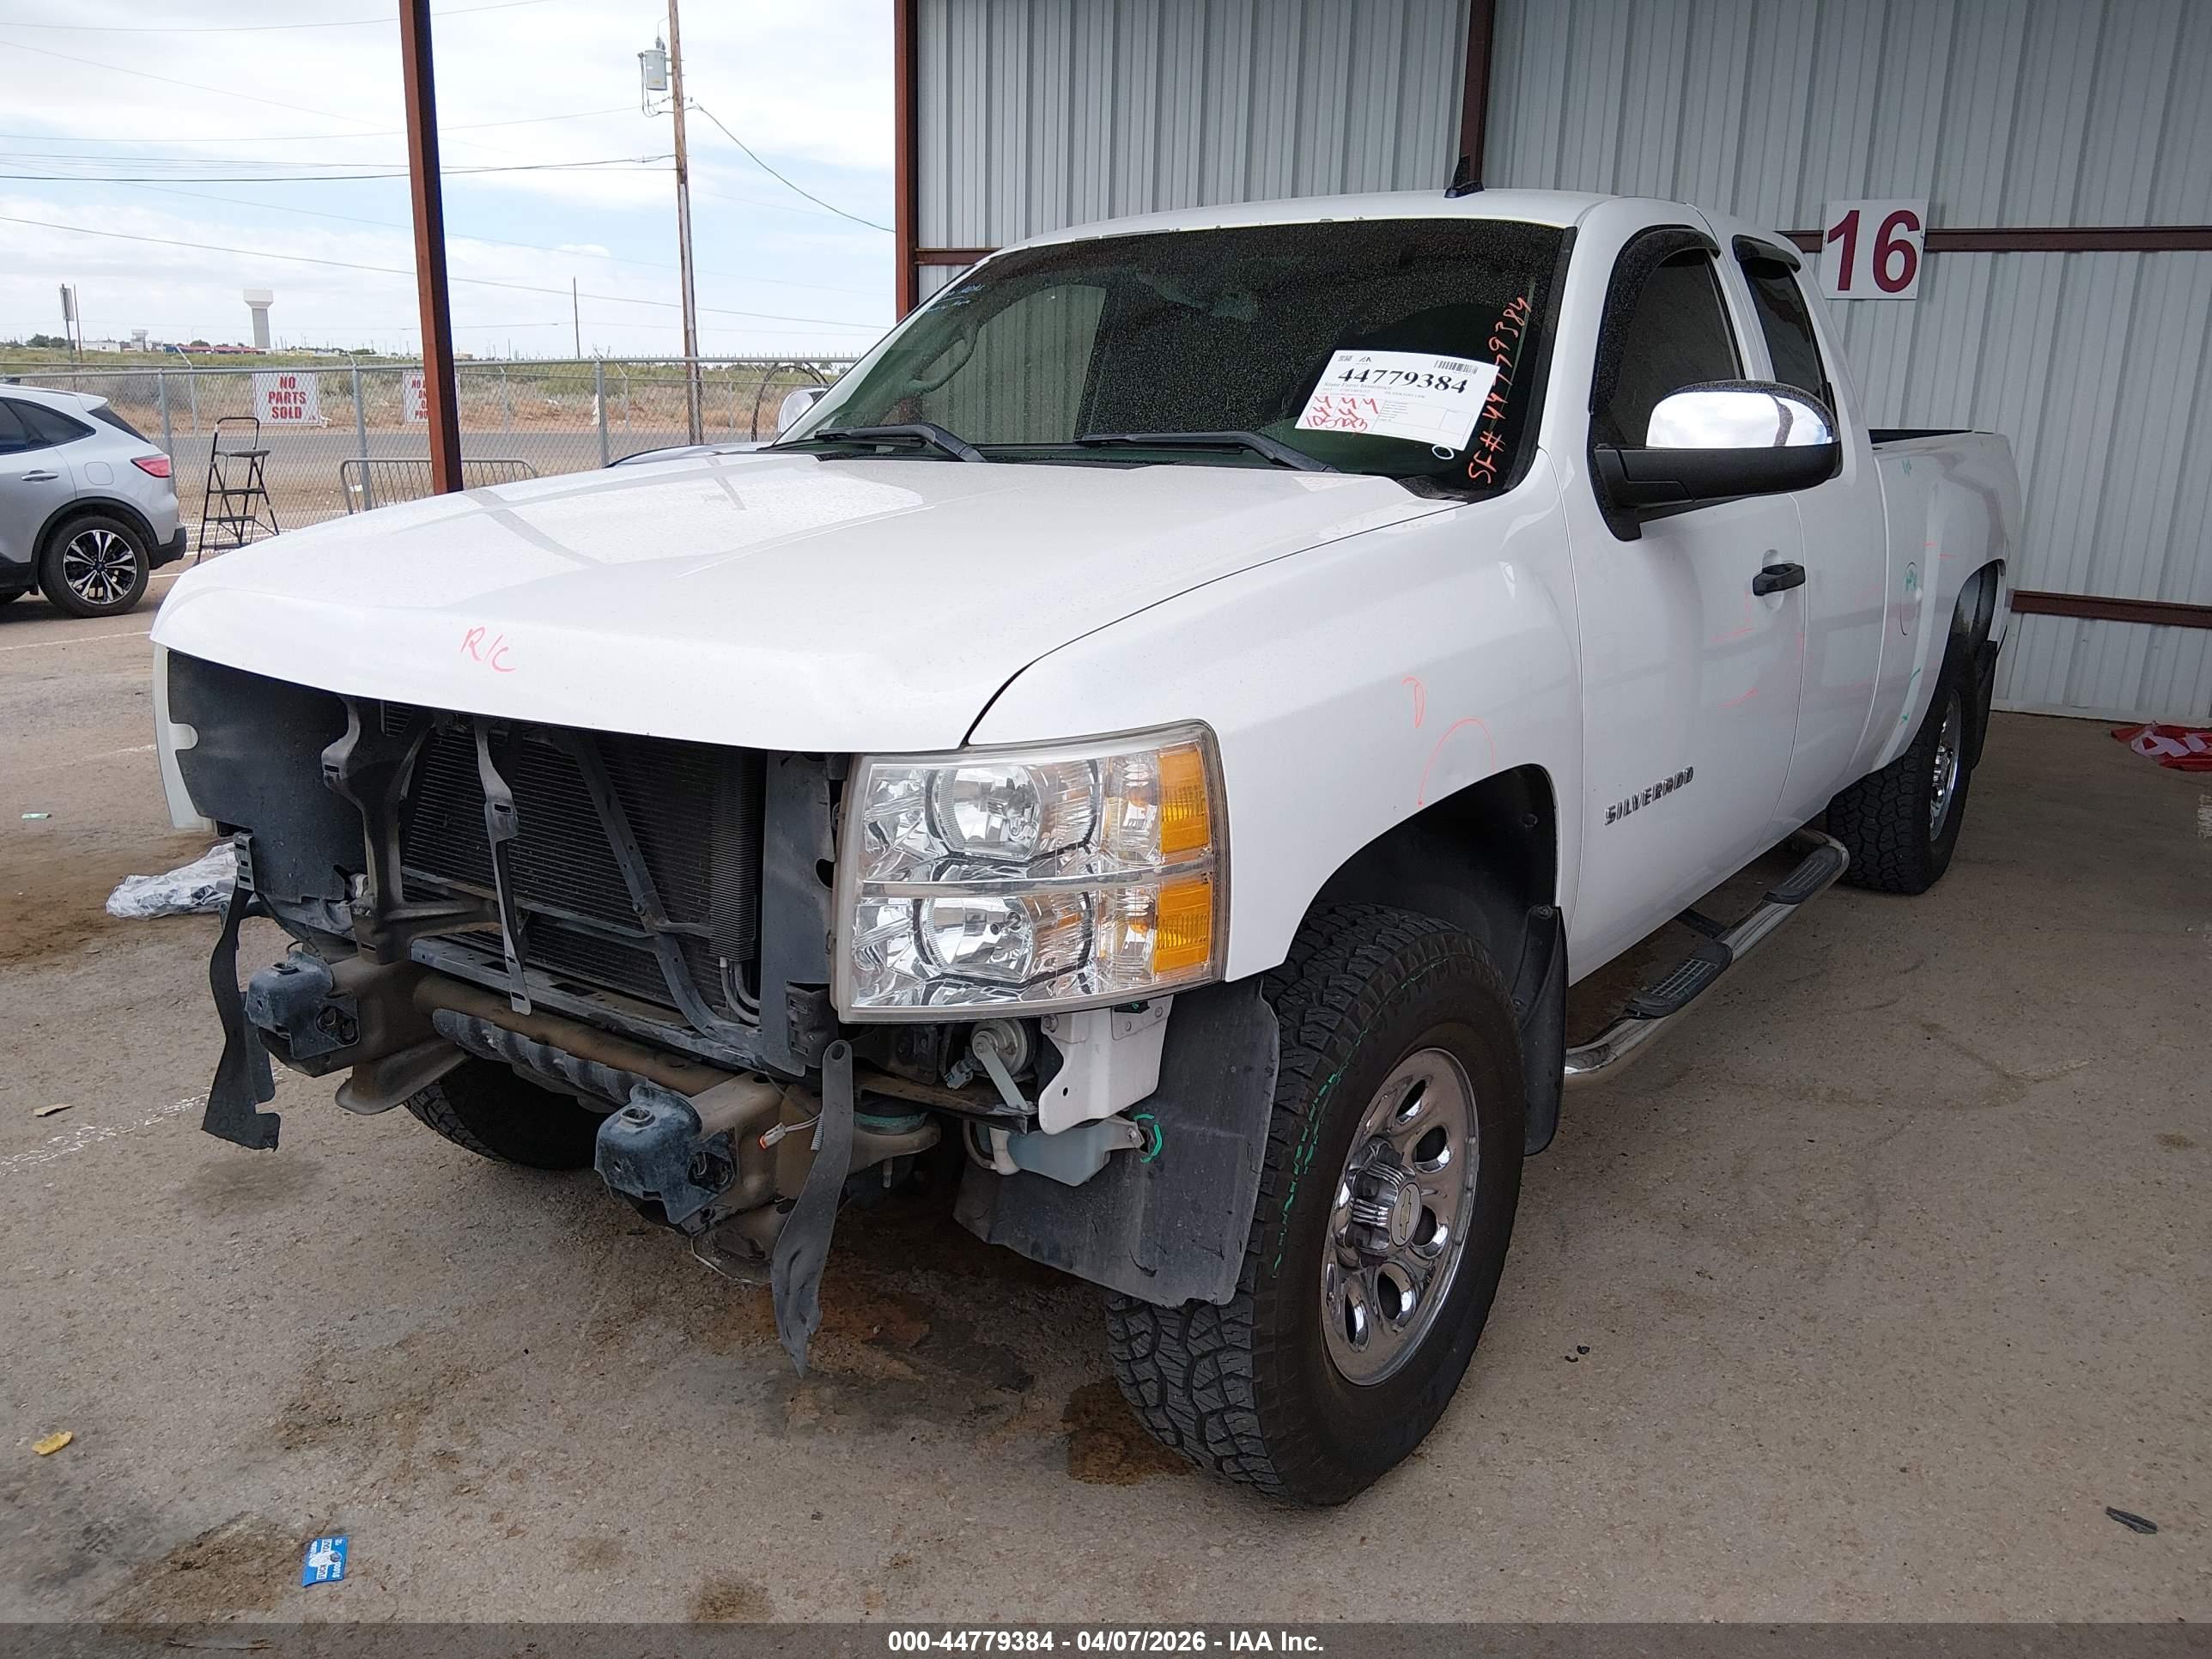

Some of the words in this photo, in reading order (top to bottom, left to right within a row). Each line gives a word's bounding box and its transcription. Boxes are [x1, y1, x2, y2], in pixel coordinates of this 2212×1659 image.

[1826, 210, 1921, 294] 16
[279, 376, 296, 390] NO
[411, 380, 422, 389] NO
[1337, 368, 1468, 394] 44779384
[268, 391, 307, 404] PARTS
[271, 406, 302, 420] SOLD
[460, 626, 516, 672] R/C
[1604, 766, 1693, 826] SILVERADO
